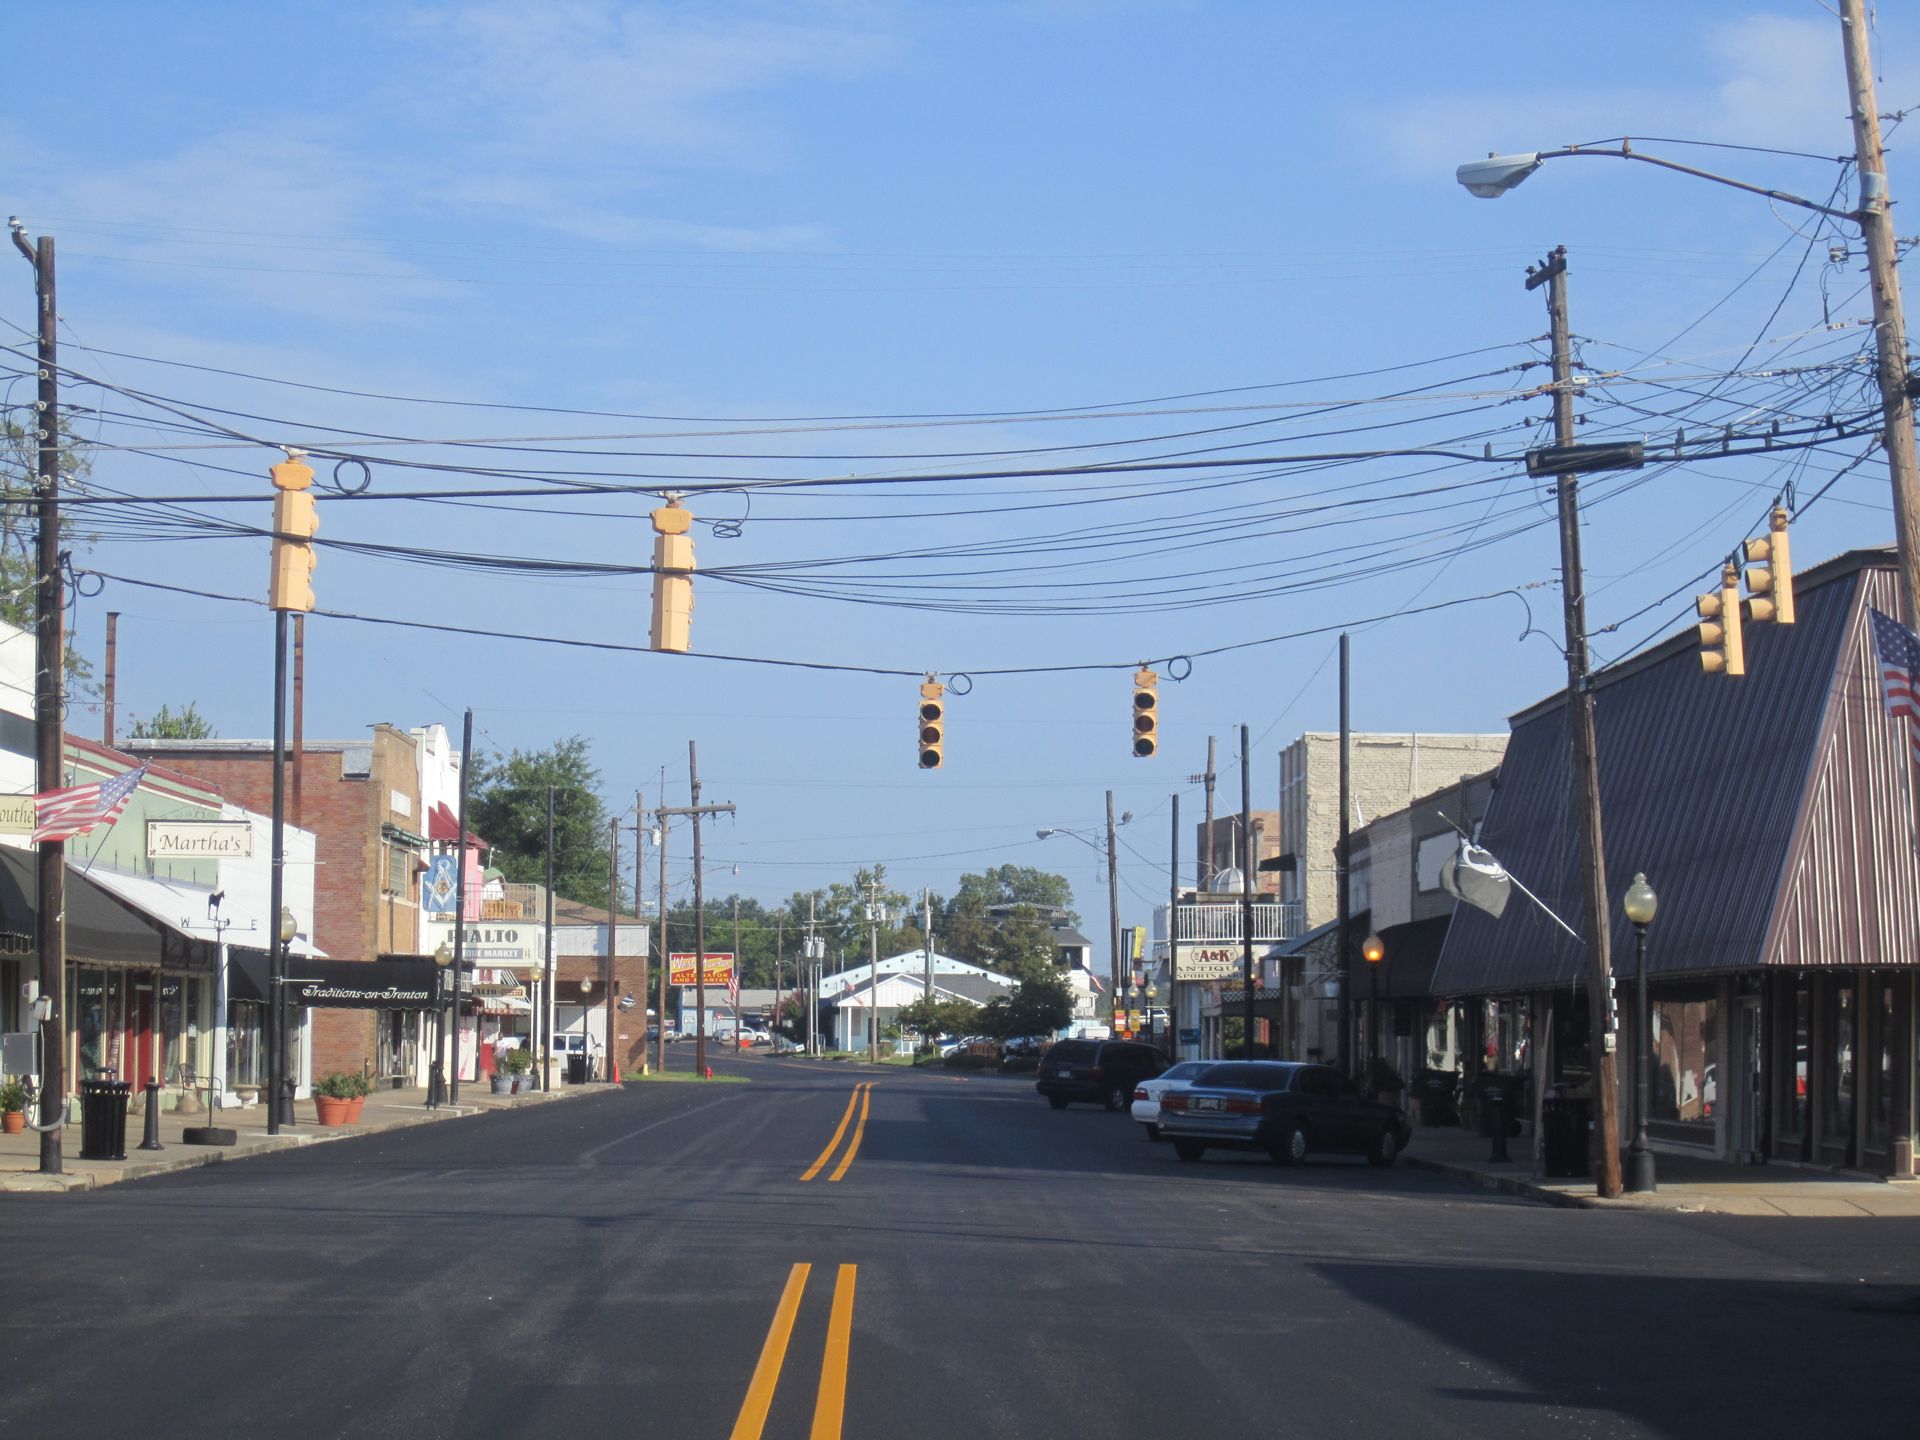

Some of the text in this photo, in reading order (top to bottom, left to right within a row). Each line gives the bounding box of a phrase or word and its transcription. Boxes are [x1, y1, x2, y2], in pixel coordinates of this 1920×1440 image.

[159, 830, 241, 851] Martha's
[181, 917, 258, 930] W E
[484, 949, 518, 958] MARKET
[1199, 949, 1230, 962] A&K
